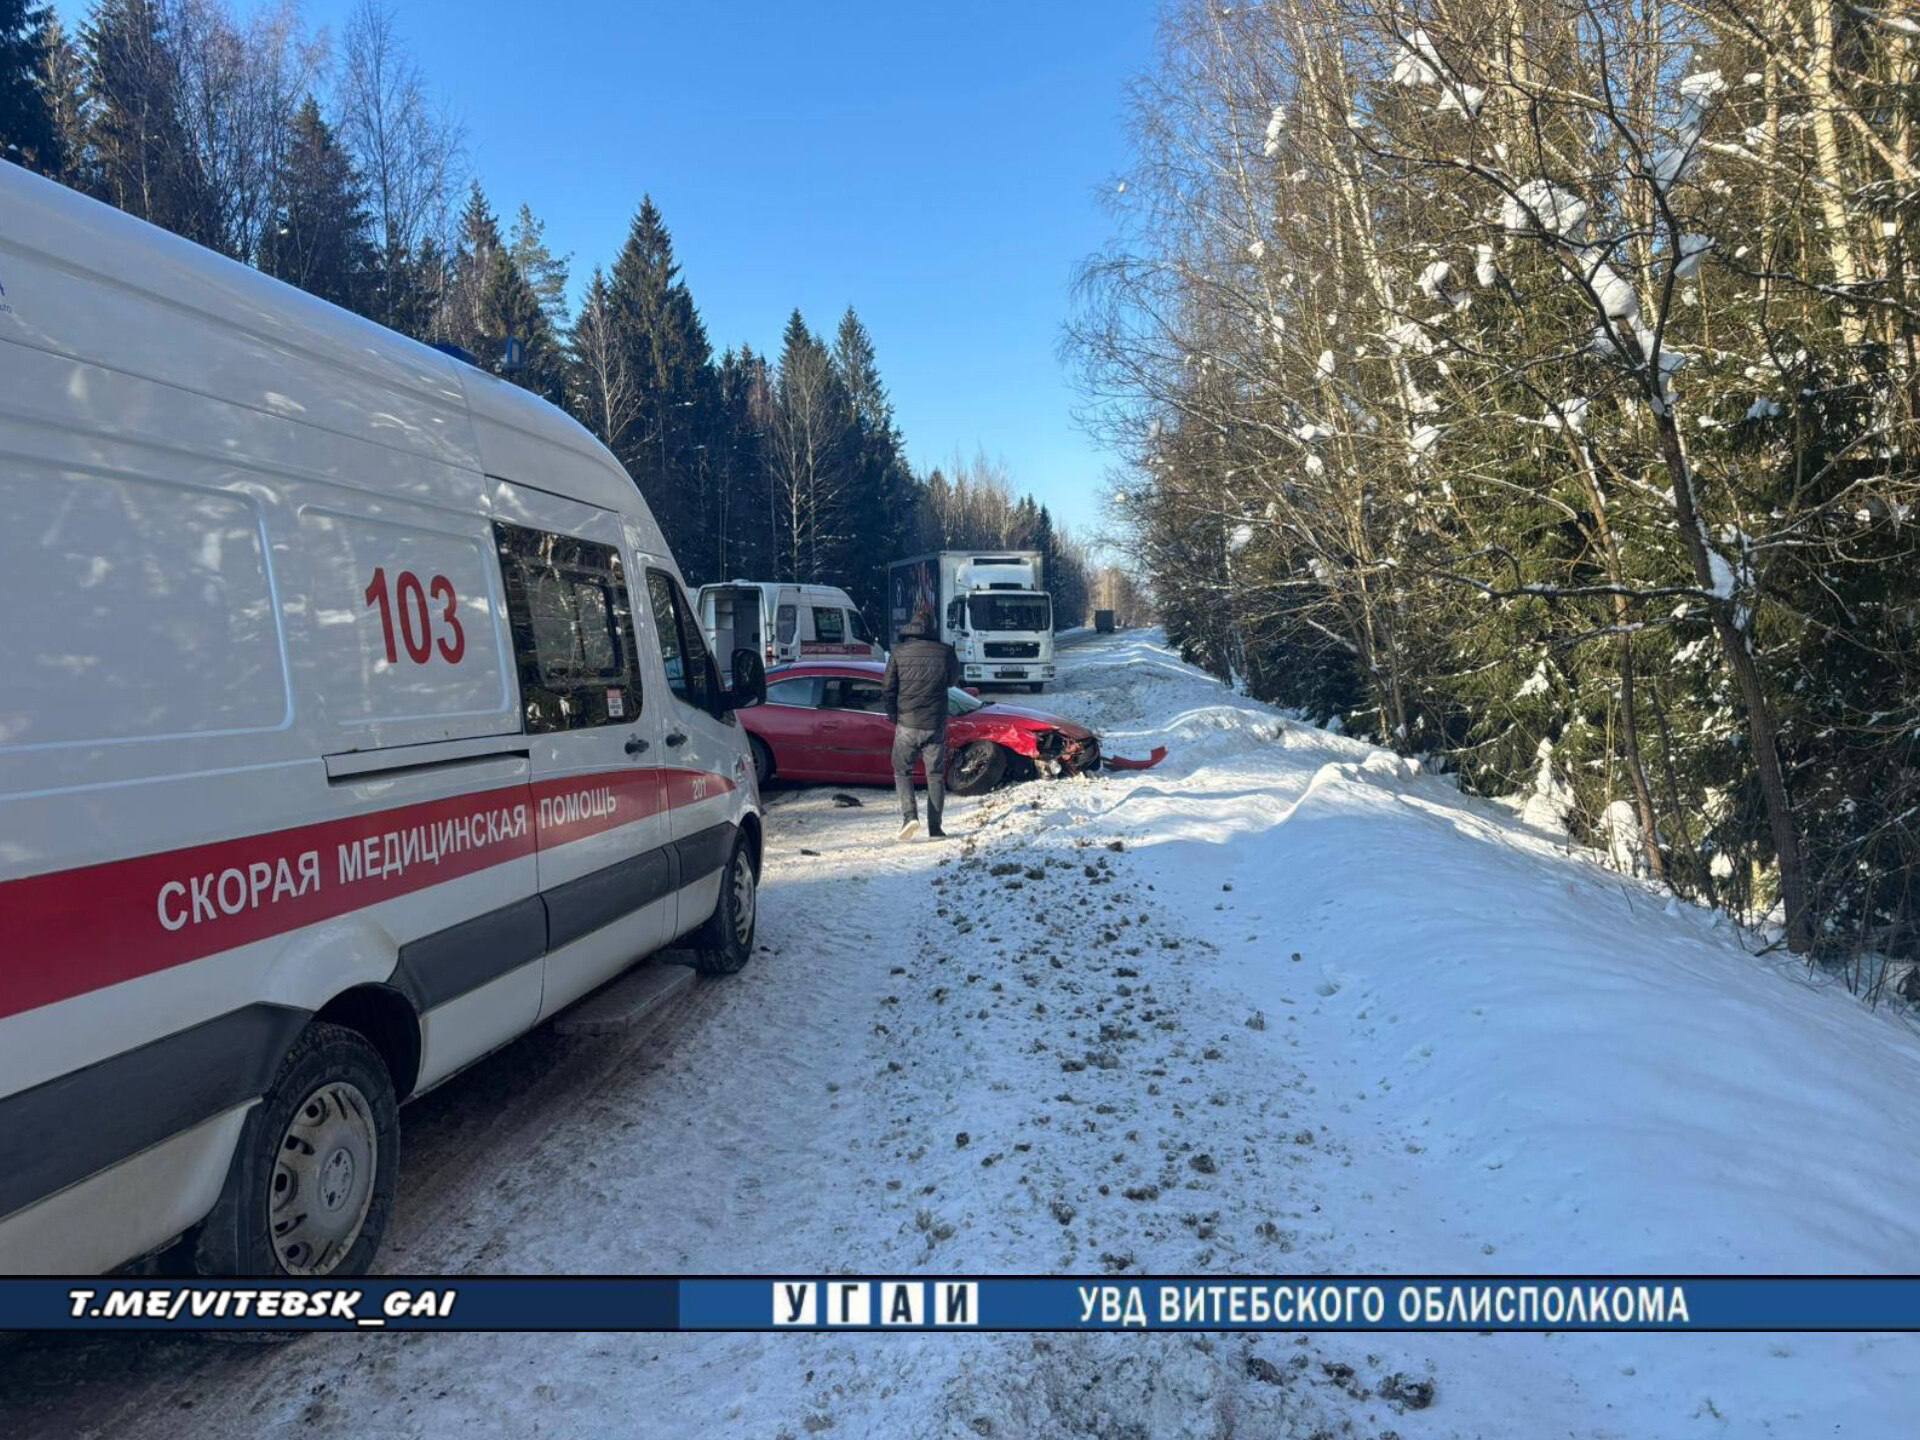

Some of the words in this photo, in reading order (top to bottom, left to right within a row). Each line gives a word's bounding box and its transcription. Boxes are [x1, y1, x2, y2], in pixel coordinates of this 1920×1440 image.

[364, 566, 466, 665] 103
[157, 850, 322, 932] СКОРАЯ
[338, 803, 528, 885] МЕДИЦИНСКАЯ
[540, 785, 618, 830] ПОМОЩЬ
